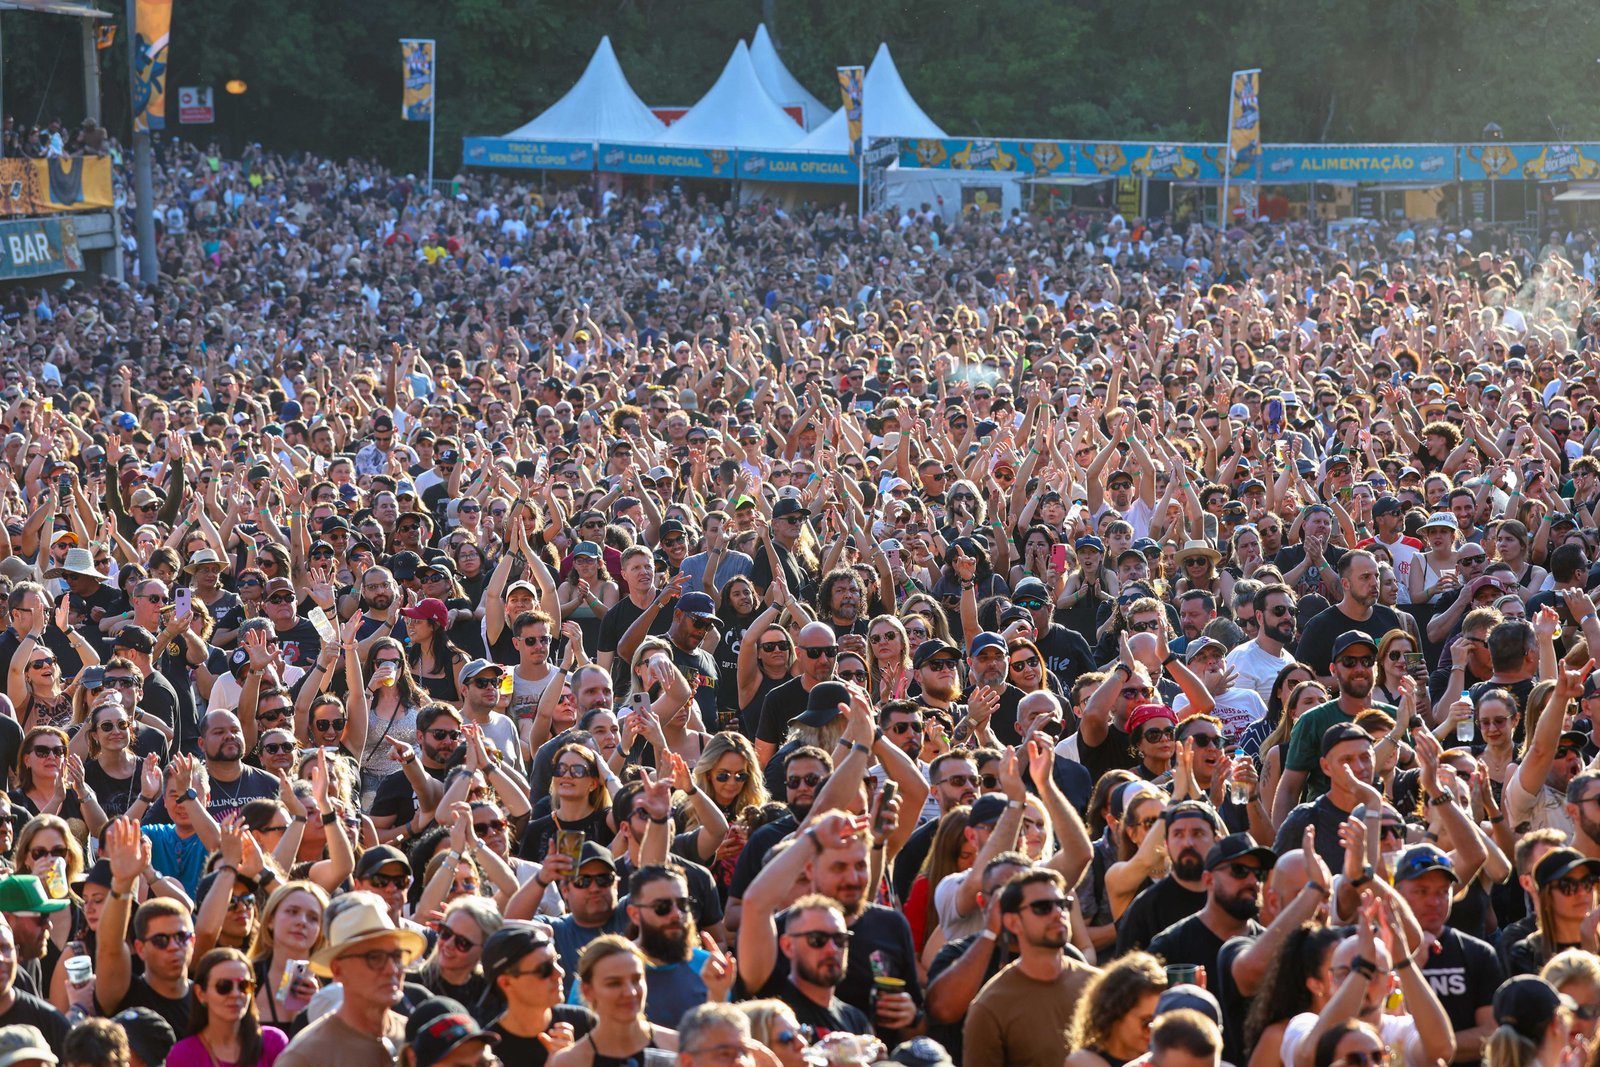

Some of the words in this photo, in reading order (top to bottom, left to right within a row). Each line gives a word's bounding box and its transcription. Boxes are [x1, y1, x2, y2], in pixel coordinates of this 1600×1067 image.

[628, 153, 655, 165] LOJA
[658, 155, 703, 168] OFICIAL
[769, 161, 797, 171] LOJA
[801, 162, 848, 174] OFICIAL
[1301, 155, 1414, 172] ALIMENTAÇÃO
[9, 233, 51, 264] BAR
[1045, 655, 1071, 671] lie
[206, 798, 237, 808] OLLING
